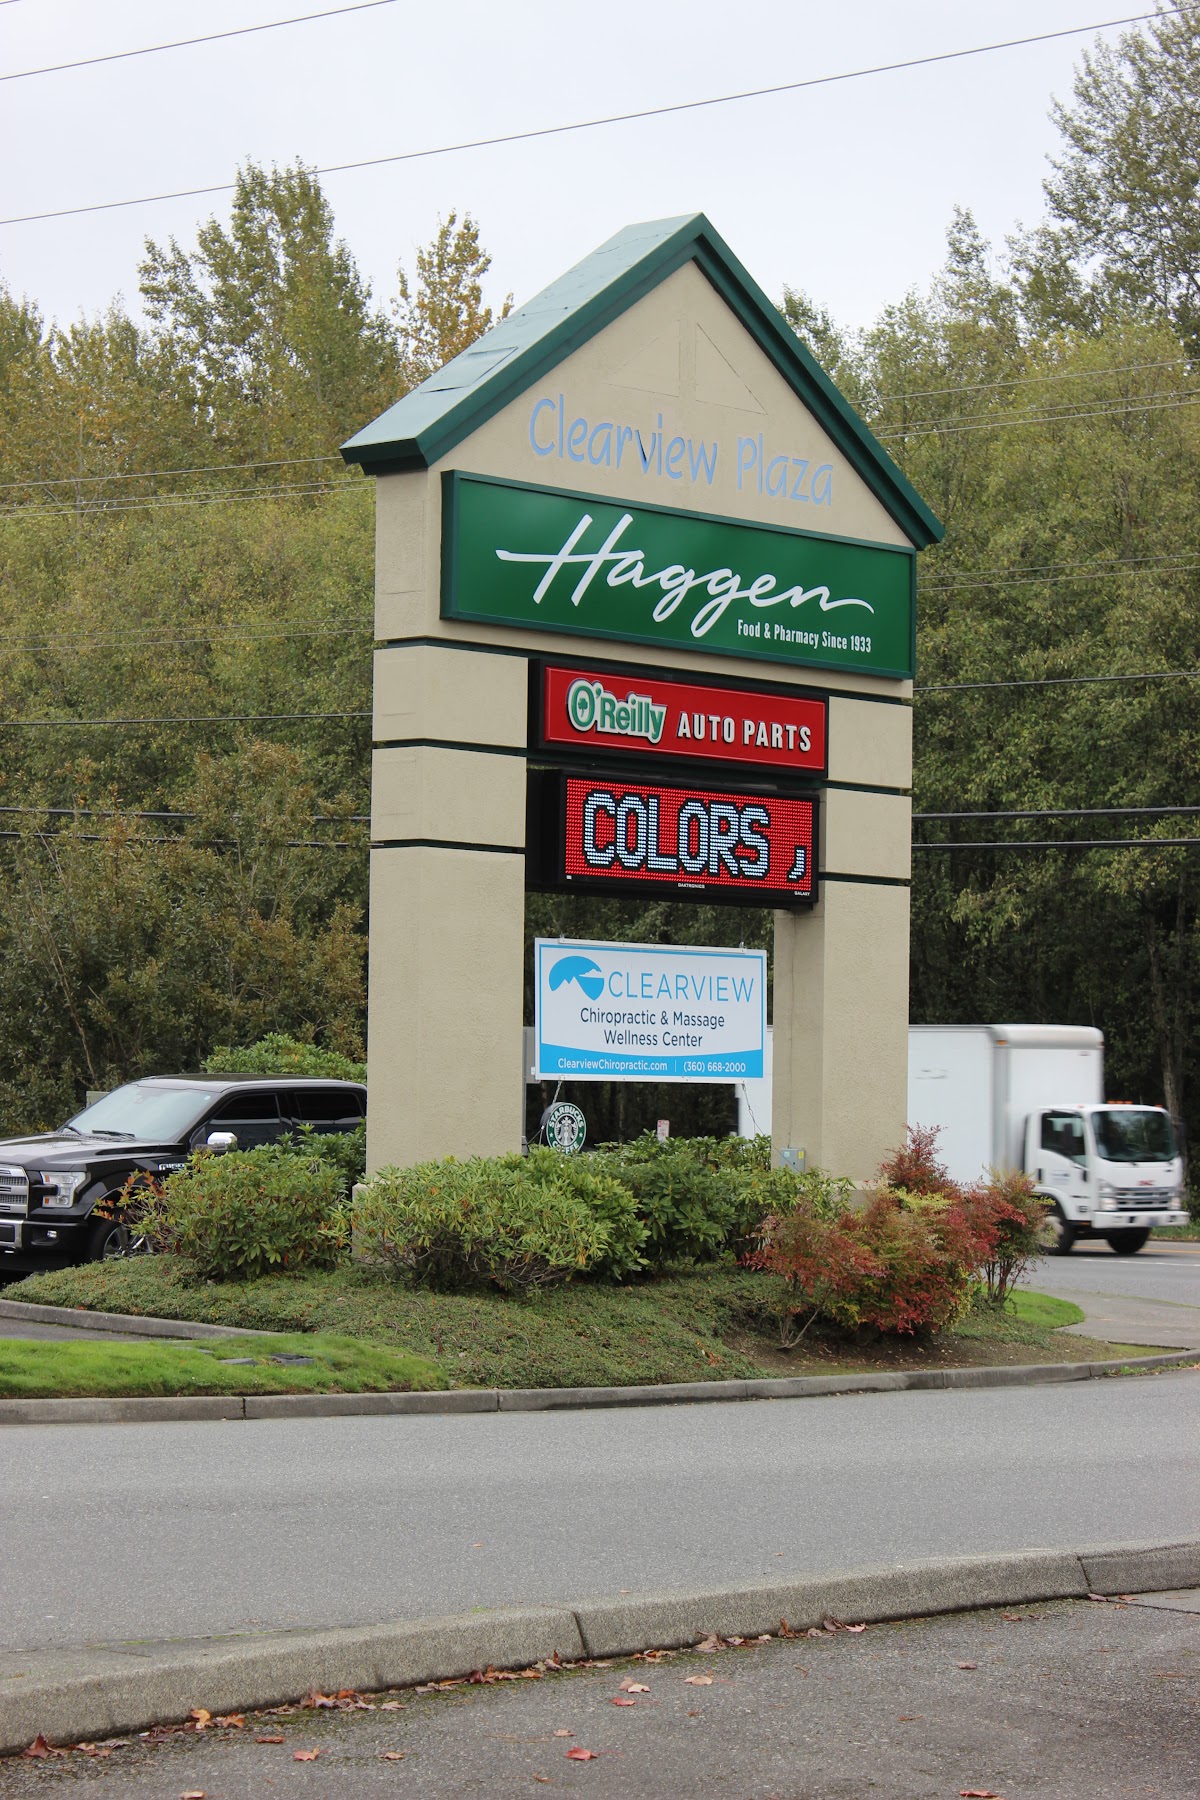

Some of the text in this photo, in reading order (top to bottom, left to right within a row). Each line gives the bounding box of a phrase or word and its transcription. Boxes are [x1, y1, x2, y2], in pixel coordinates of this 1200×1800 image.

[529, 394, 834, 506] Clearview Plaza
[495, 513, 875, 638] Haggen
[737, 619, 872, 653] Food & Pharmacy Since 1933
[570, 684, 664, 740] O'Reilly
[677, 711, 812, 752] AUTO PARTS
[584, 792, 770, 877] COLORS
[608, 971, 754, 1003] CLEARVIEW
[580, 1007, 725, 1030] Chiropractic & Massage
[604, 1029, 703, 1047] Wellness Center
[557, 1058, 668, 1071] ClearviewChiropractic.com
[683, 1061, 747, 1073] (360) 668-2000
[549, 1105, 584, 1128] STARBUCKS
